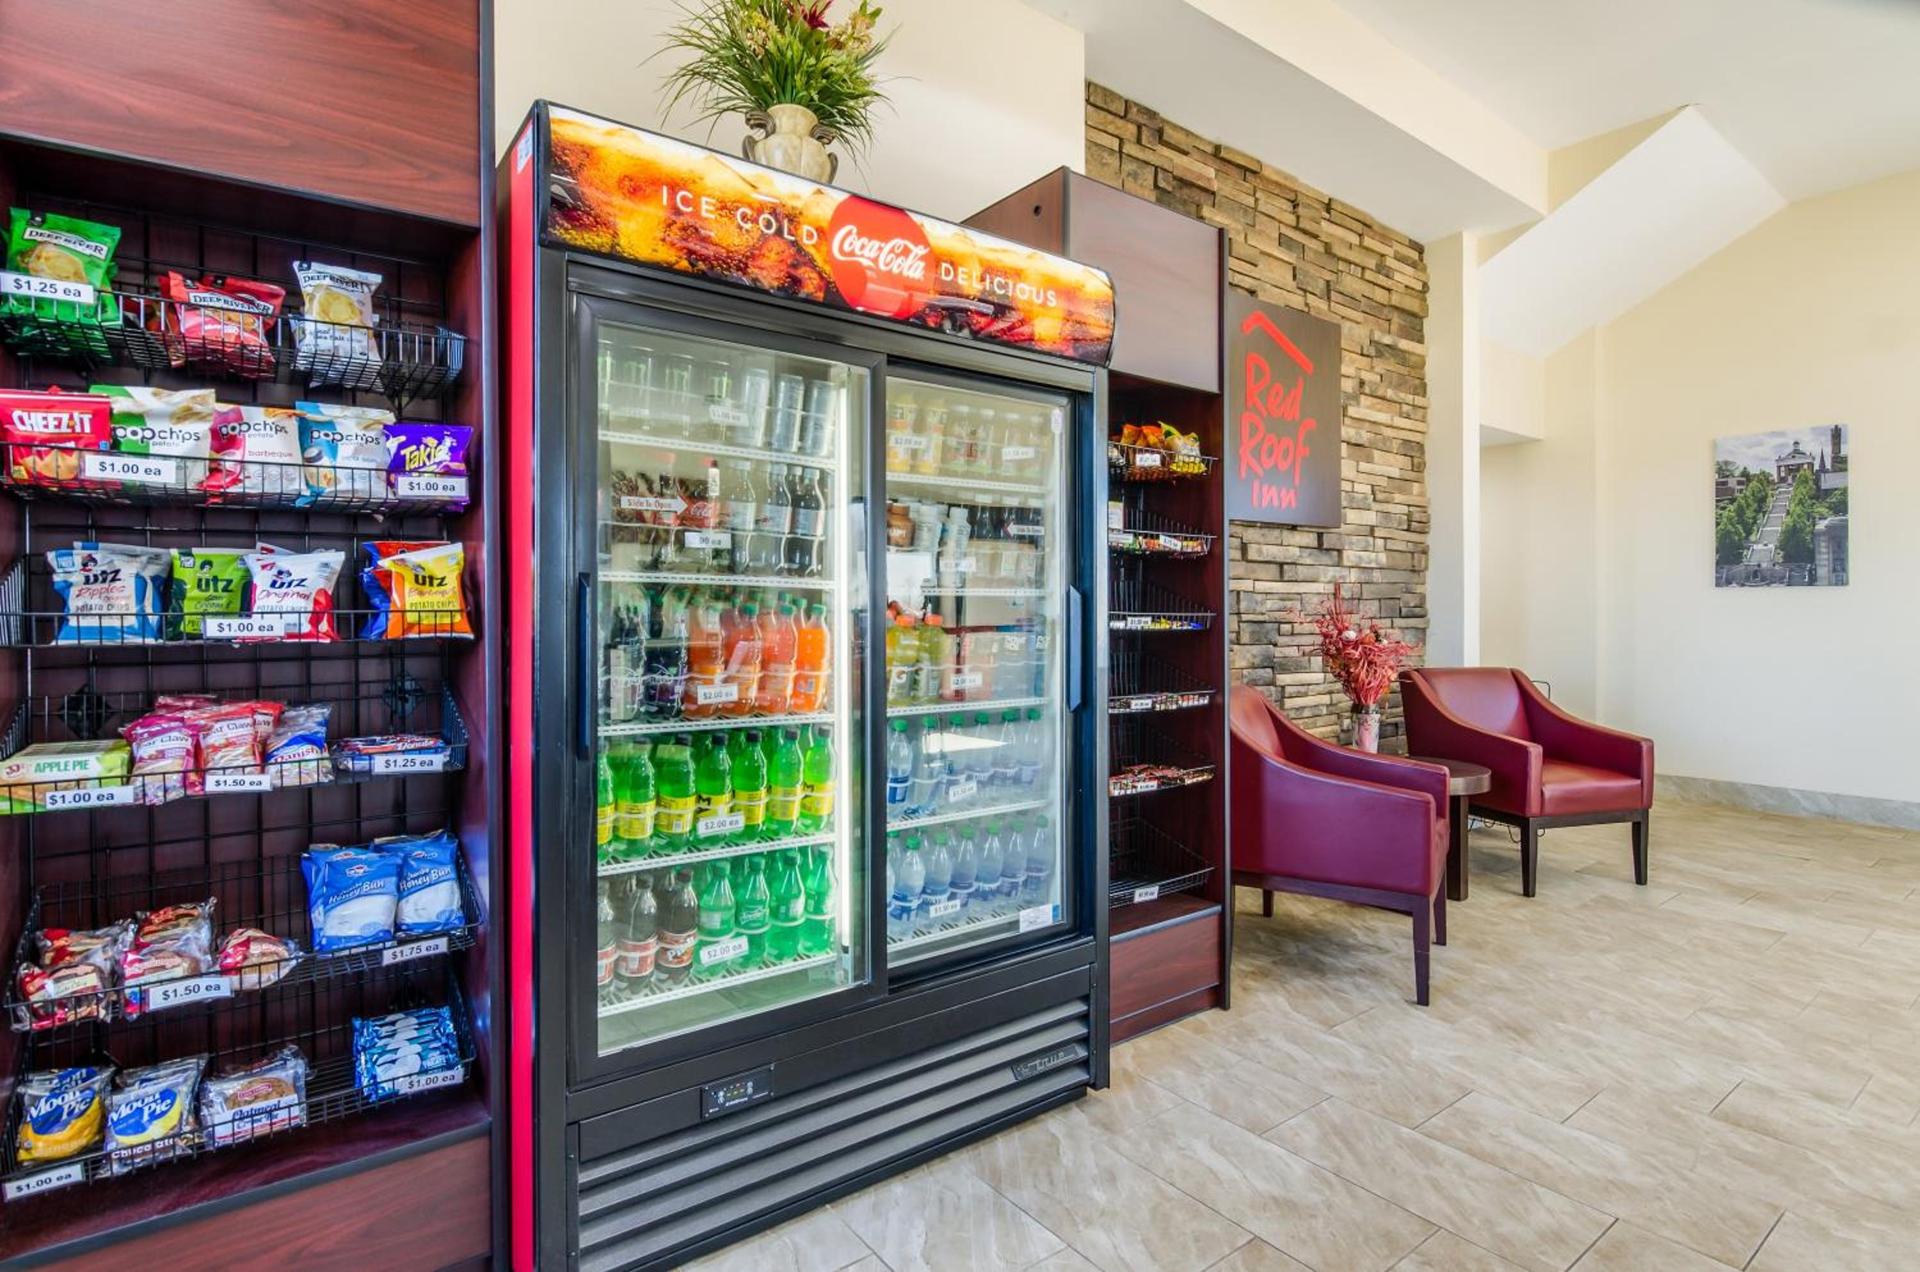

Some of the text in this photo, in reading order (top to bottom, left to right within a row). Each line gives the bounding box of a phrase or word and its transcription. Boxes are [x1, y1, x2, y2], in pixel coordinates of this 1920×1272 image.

[661, 184, 818, 246] ICE COLD
[28, 229, 105, 256] DEEP RIVER
[832, 224, 930, 281] Coca-Cola
[13, 278, 82, 298] $1.25 ea
[940, 262, 1058, 308] DELICIOUS
[193, 294, 221, 304] DEEP
[1244, 352, 1305, 422] Red
[12, 410, 93, 434] CHEEZ-IT
[112, 426, 201, 444] popchips
[310, 430, 381, 446] popchips
[1239, 411, 1318, 486] Roof
[99, 461, 162, 477] $1.00 ea
[408, 481, 456, 492] $1.00 ea
[216, 622, 275, 633] $1.00 ea
[34, 759, 90, 774] APPLE PIE
[384, 758, 434, 769] $1.25 ea
[214, 778, 263, 787] $1.50 ea
[49, 792, 115, 806] $1.00 ea
[400, 867, 452, 892] Honey Bun
[328, 886, 361, 905] Honey
[361, 879, 384, 891] Bun
[391, 943, 440, 961] $1.75 ea
[161, 983, 222, 1002] $1.50 ea
[407, 1073, 456, 1090] $1.00 ea
[26, 1089, 81, 1122] Moon
[61, 1098, 92, 1121] Pie
[108, 1091, 162, 1125] Moon
[141, 1097, 173, 1123] Pie
[15, 1172, 73, 1193] $1.00 ea
